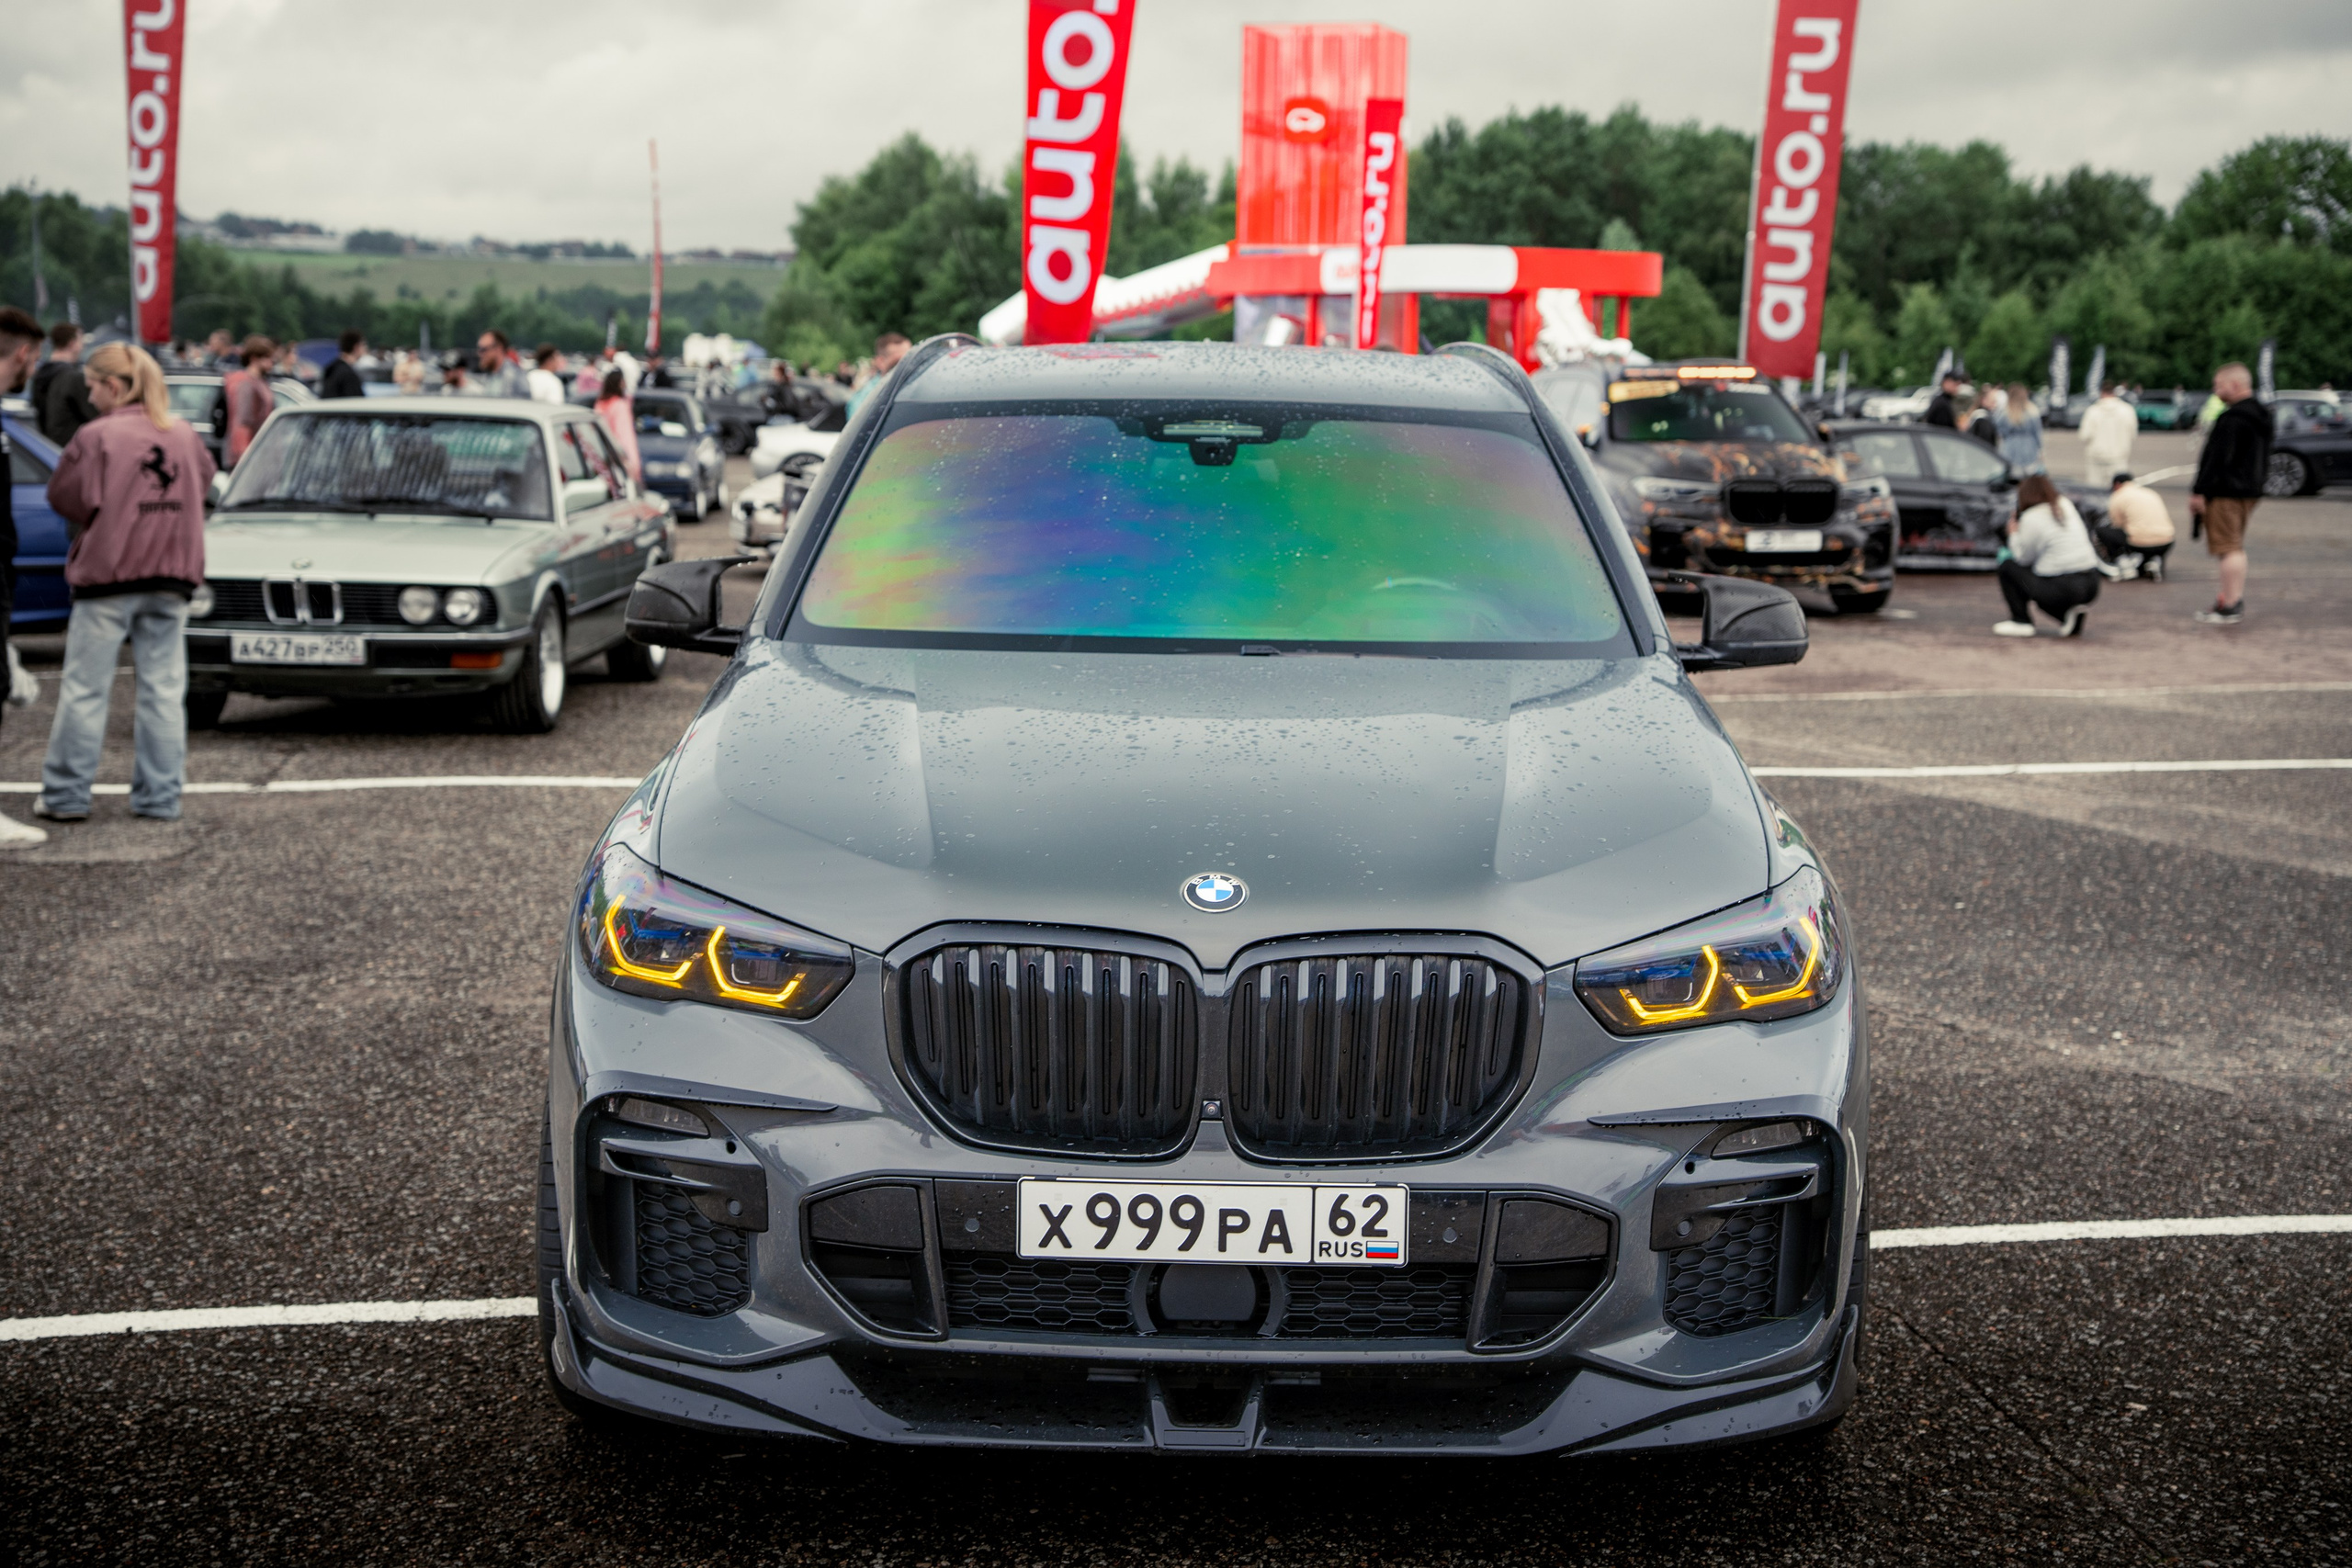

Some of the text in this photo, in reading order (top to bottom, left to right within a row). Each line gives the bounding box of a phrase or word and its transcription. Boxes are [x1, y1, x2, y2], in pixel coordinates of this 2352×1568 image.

[1757, 17, 1842, 342] auto.ru
[1328, 1192, 1389, 1238] 62
[1318, 1240, 1363, 1258] RUS
